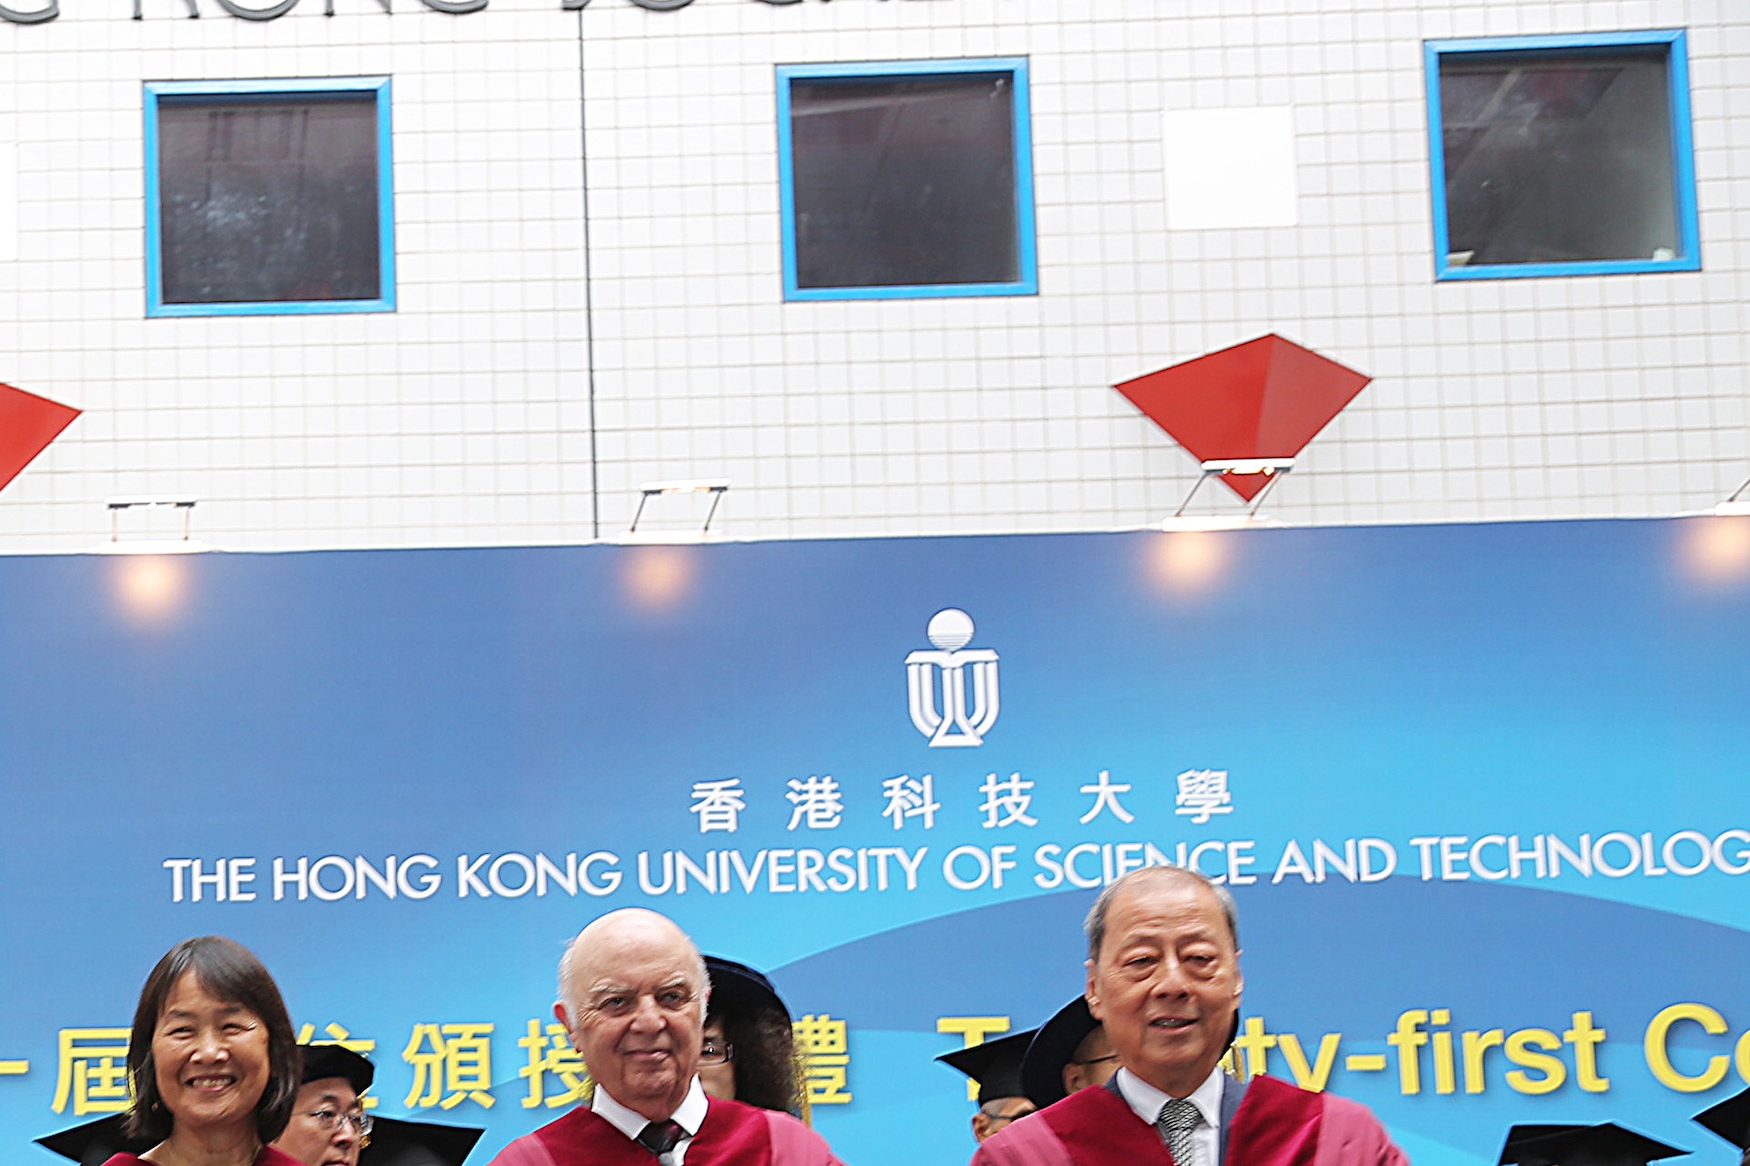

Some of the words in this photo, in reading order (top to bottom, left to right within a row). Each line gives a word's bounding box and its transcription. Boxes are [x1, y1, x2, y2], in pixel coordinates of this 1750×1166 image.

[689, 768, 1236, 834] 香港科技大學
[163, 857, 256, 903] THE
[272, 854, 442, 901] HONG
[457, 850, 623, 899] KONG
[638, 845, 929, 896] UNIVERSITY
[942, 844, 1017, 891] OF
[1271, 837, 1398, 885] AND
[1408, 828, 1750, 881] TECHNOLOG
[1643, 1002, 1750, 1093] C
